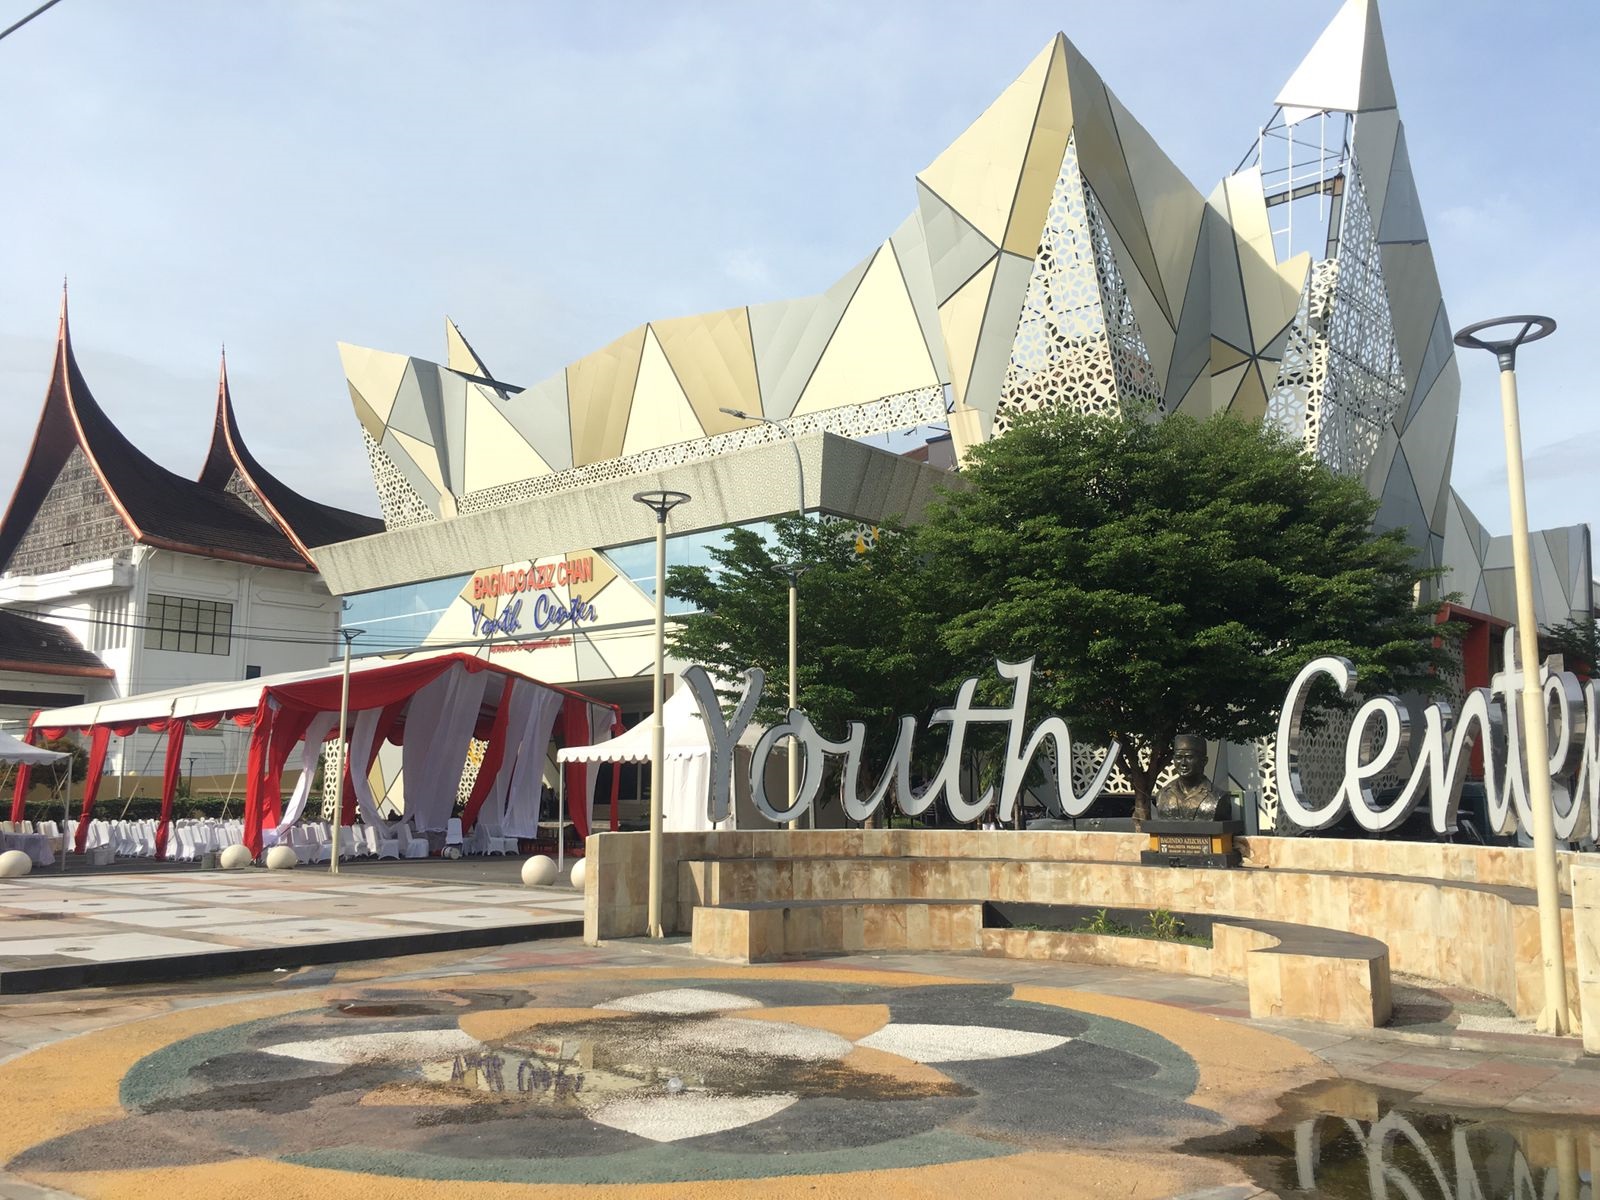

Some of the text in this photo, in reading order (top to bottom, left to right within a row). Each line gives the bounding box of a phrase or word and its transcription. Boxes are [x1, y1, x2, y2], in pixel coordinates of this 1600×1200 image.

[474, 556, 593, 599] BAGINDO AZIZ CHAN
[472, 593, 598, 637] Youth Center
[681, 655, 1122, 823] Youth
